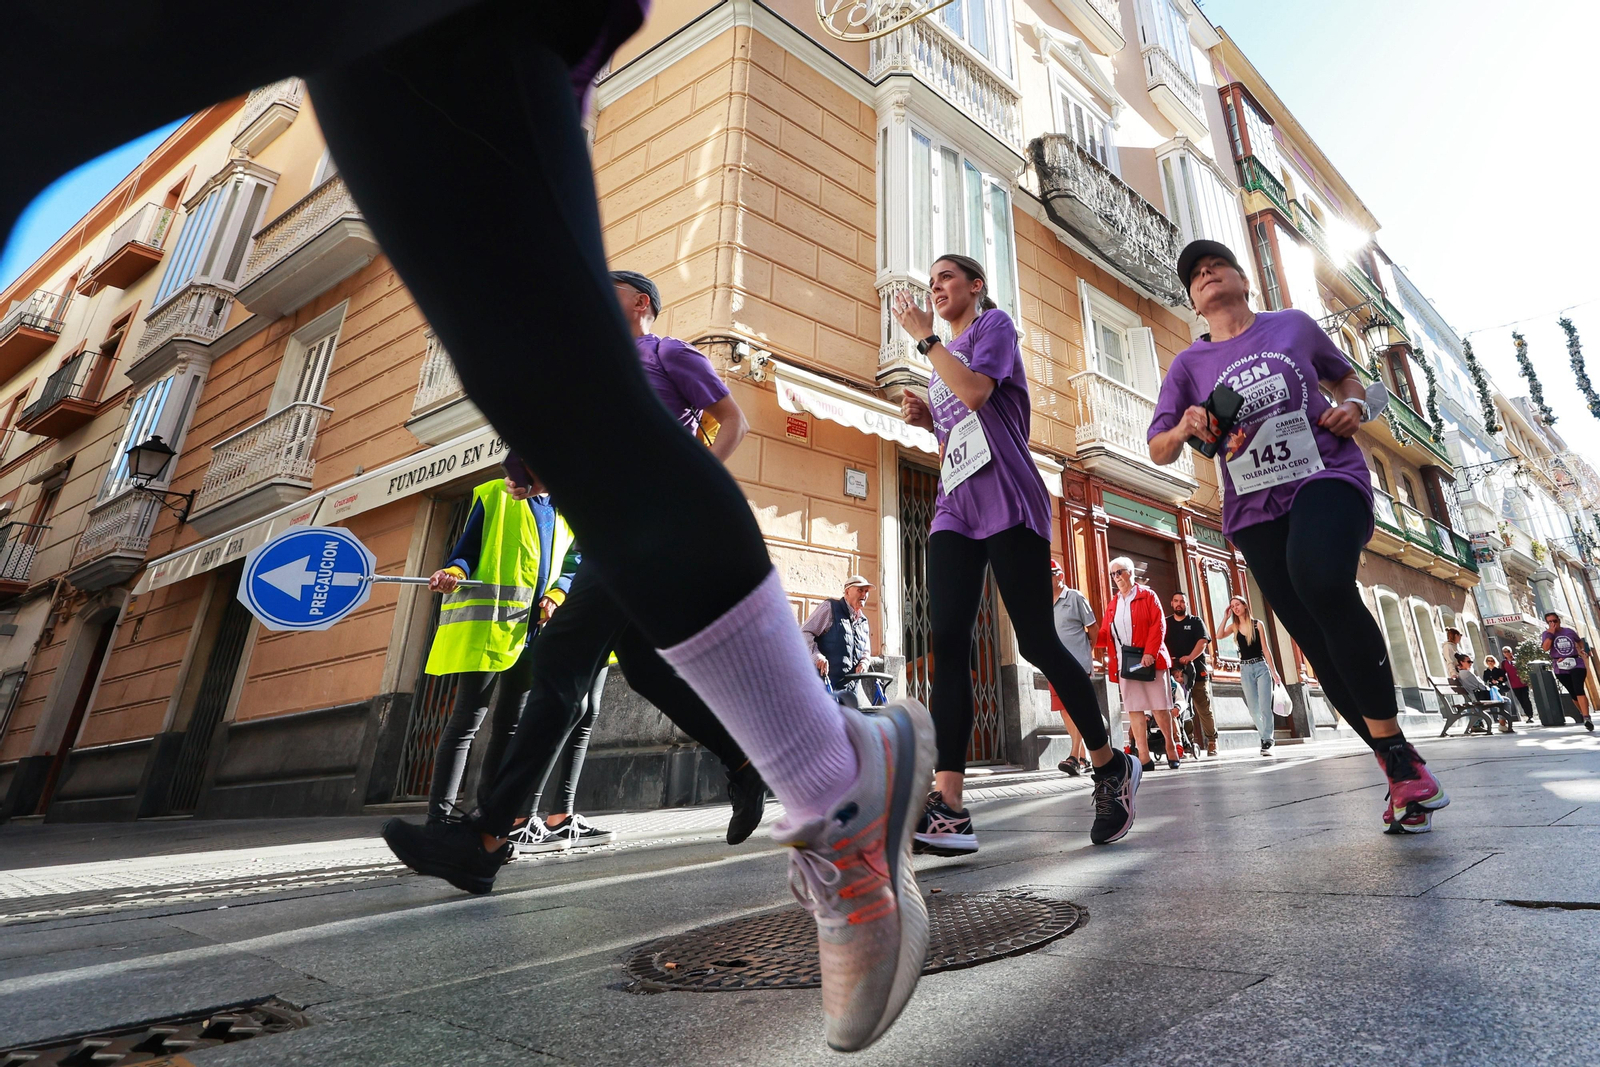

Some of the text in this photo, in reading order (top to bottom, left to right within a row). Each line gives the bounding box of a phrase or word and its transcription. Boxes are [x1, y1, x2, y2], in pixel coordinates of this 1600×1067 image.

[1213, 351, 1309, 410] NACIONAL CONTRA LA VIOLE
[1227, 361, 1271, 391] 25N
[1236, 406, 1251, 419] 00
[1251, 401, 1261, 410] 21
[1261, 396, 1272, 406] 21
[1271, 390, 1286, 401] 30
[1244, 383, 1276, 403] HORAS
[1275, 416, 1305, 429] CARRERA
[947, 440, 967, 469] 187
[1241, 457, 1309, 481] TOLERANCIA CERO
[1249, 440, 1292, 469] 143
[387, 454, 457, 497] FUNDADO
[460, 443, 484, 468] EN
[201, 547, 221, 567] BAR
[309, 541, 340, 616] PRECAUCION
[1498, 615, 1521, 623] SIGLO
